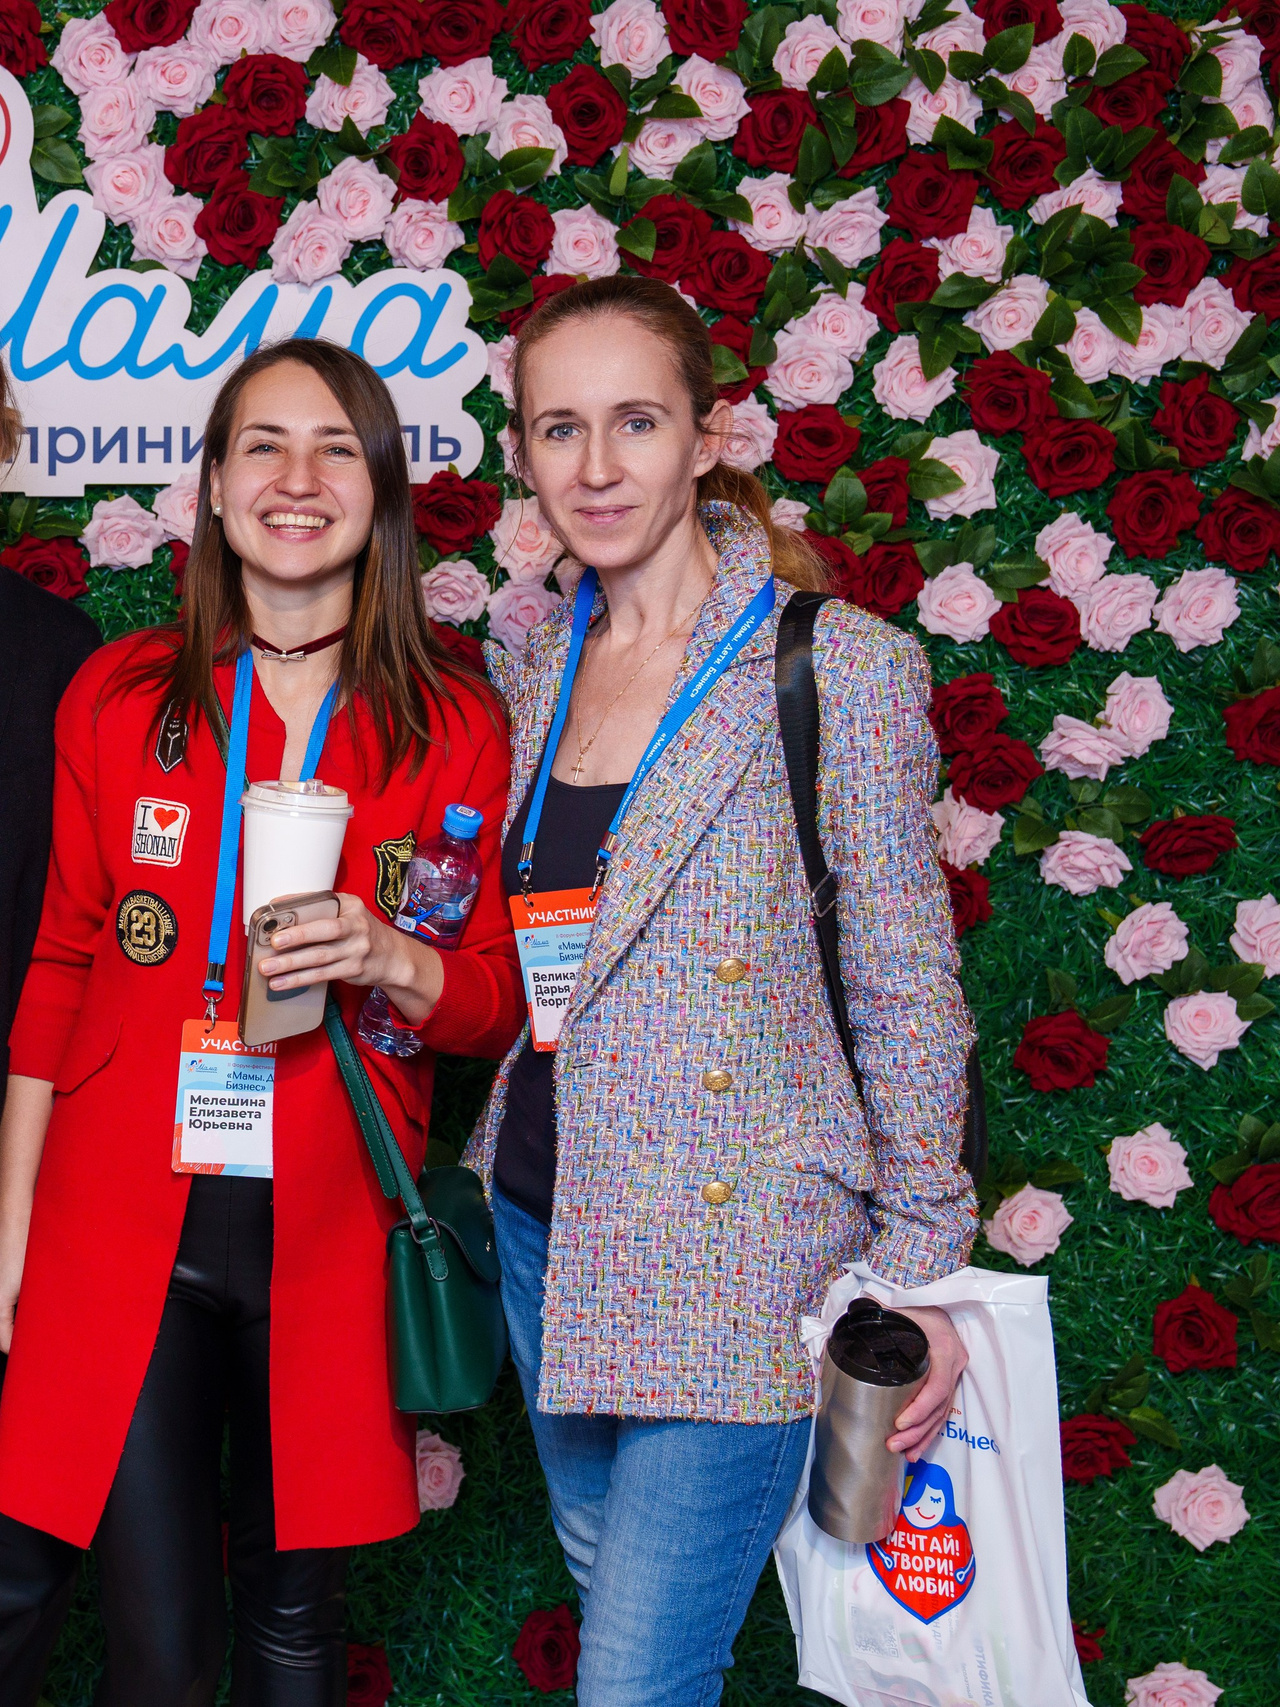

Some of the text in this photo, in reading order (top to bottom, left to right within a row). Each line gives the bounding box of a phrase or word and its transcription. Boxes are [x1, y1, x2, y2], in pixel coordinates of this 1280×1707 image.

[137, 804, 151, 830] I
[135, 834, 177, 858] SHONAN
[130, 909, 157, 947] 23
[559, 951, 585, 961] Бизне
[533, 971, 578, 983] Велика
[534, 984, 570, 996] Дарья
[536, 997, 570, 1008] Георг
[232, 1062, 274, 1070] Форум-фестива
[225, 1081, 266, 1092] Бизнес»
[190, 1094, 266, 1107] Мелешина
[189, 1106, 262, 1119] Елизавета
[188, 1118, 253, 1131] Юрьевна
[885, 1529, 960, 1557] МЕЧТАЙ!
[890, 1550, 955, 1576] ТВОРИ!
[894, 1573, 955, 1599] ЛЮБИ!
